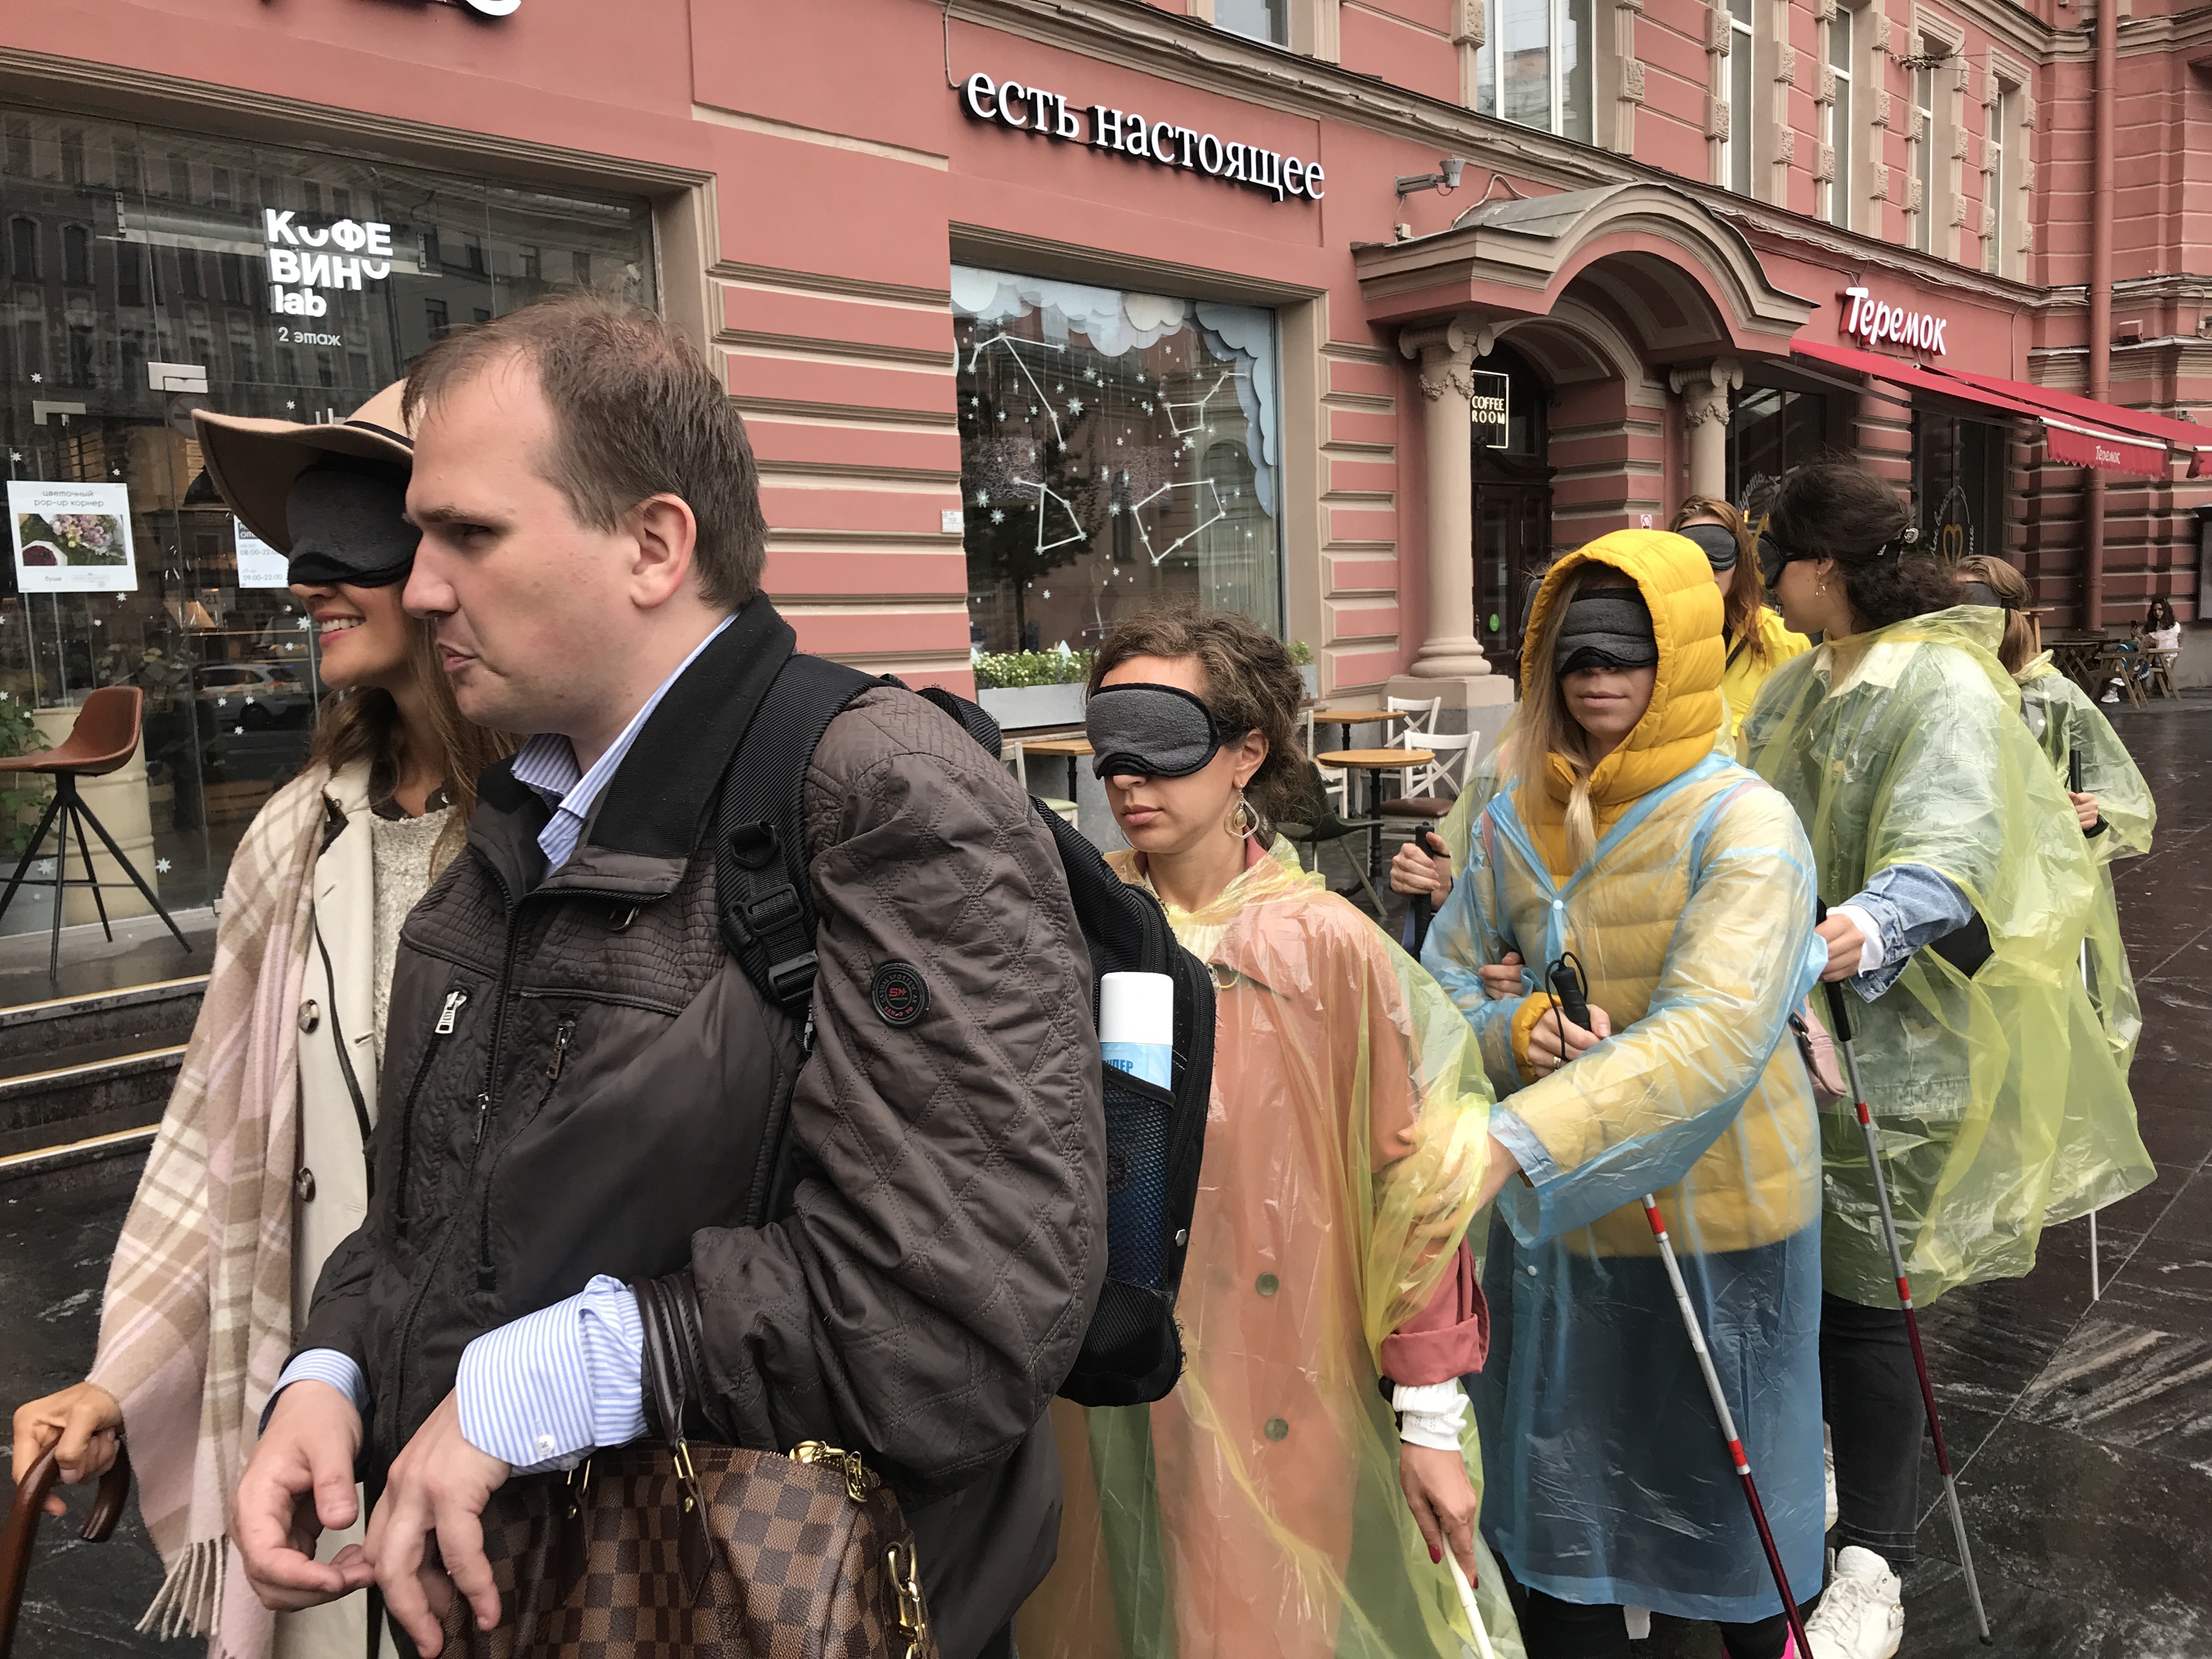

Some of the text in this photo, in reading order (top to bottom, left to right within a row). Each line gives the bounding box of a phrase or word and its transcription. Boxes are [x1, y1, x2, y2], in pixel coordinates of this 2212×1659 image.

[968, 72, 1325, 202] есть настоящее
[274, 284, 328, 318] lab
[1845, 286, 1947, 356] Теремок
[278, 326, 342, 347] 2 этаж
[1471, 396, 1505, 411] COFFEE
[1471, 410, 1505, 425] ROOM
[71, 500, 104, 508] корнер
